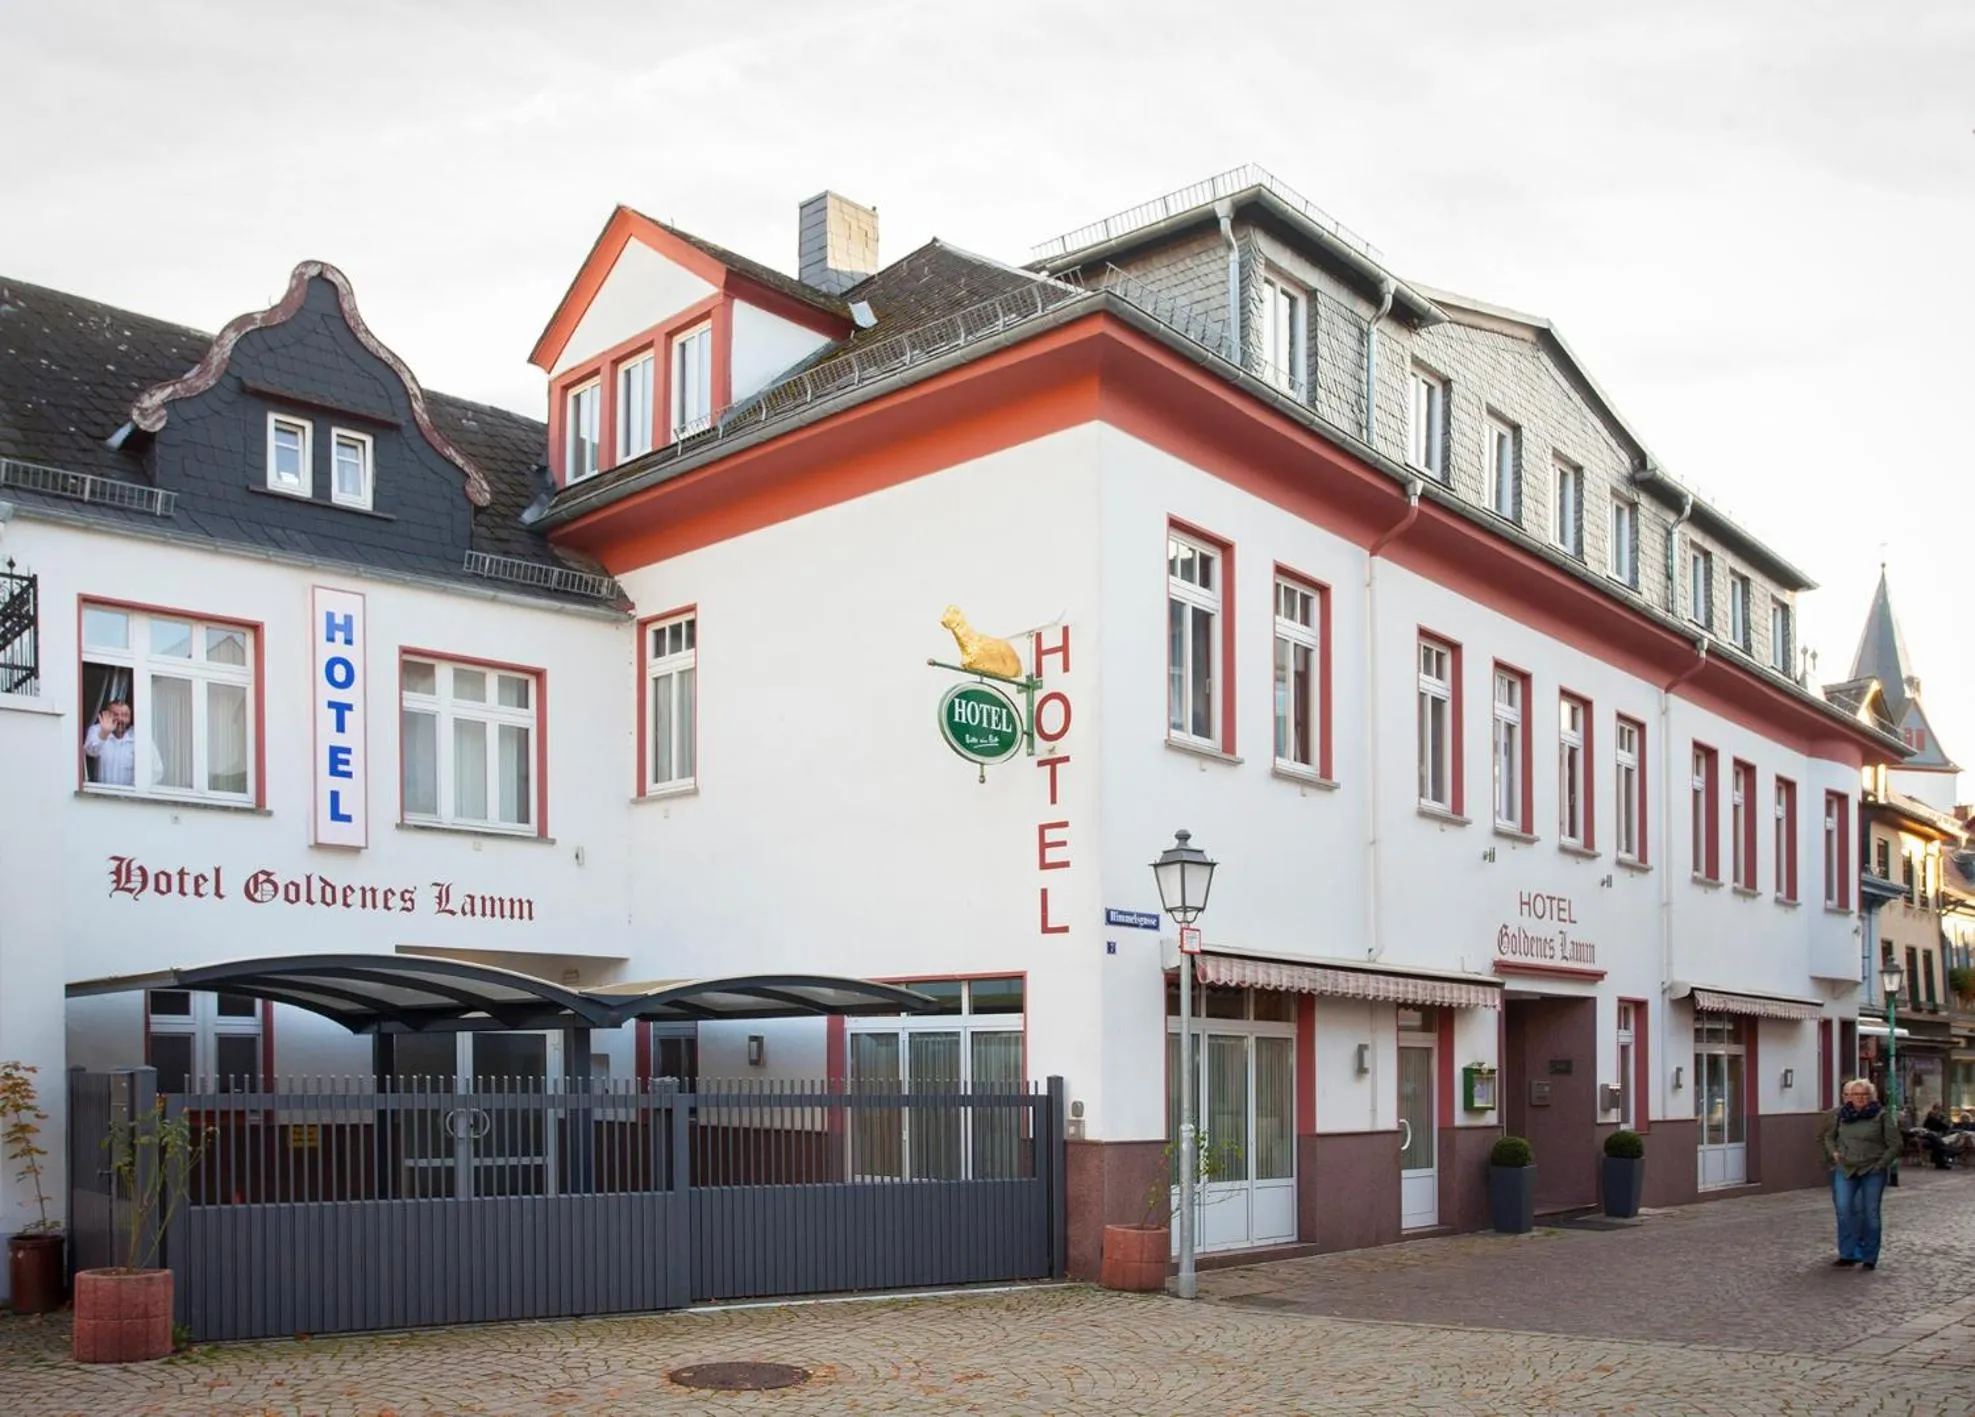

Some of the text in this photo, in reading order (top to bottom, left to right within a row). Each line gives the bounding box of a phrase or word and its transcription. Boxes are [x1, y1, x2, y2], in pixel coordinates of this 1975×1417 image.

[324, 611, 356, 824] HOTEL
[954, 697, 1012, 733] HOTEL
[1035, 625, 1071, 935] HOTEL
[109, 855, 534, 922] Hotel Goldenes Lamm
[1519, 890, 1578, 925] HOTEL
[1497, 923, 1596, 964] Goldenes Lamm
